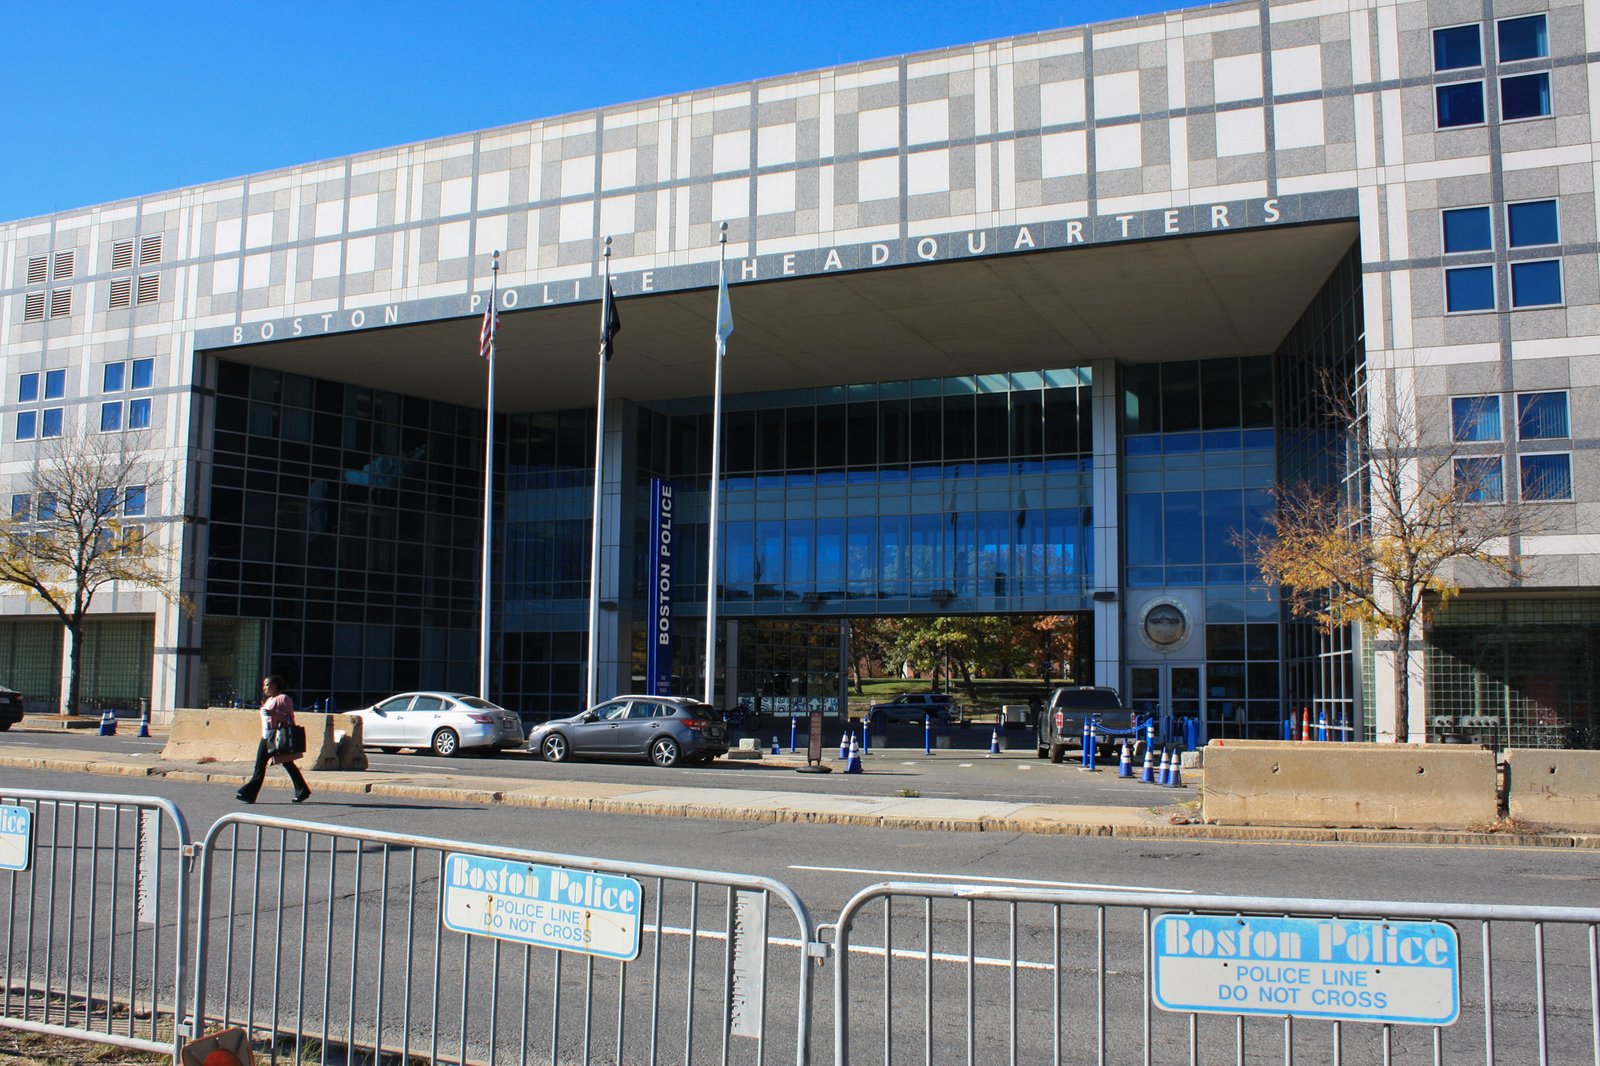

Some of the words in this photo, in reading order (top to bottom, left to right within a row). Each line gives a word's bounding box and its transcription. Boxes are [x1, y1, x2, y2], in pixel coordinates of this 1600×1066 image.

[233, 304, 399, 344] BOSTON
[741, 199, 1280, 279] HEADQUARTERS
[661, 485, 672, 557] POLICE
[659, 563, 671, 645] BOSTON
[453, 857, 540, 898] Boston
[550, 870, 635, 912] Police
[484, 912, 503, 928] DO
[509, 917, 536, 934] NOT
[543, 923, 592, 943] CROSS
[496, 899, 544, 919] POLICE
[551, 907, 580, 925] LINE
[1165, 919, 1301, 959] Boston
[1318, 923, 1449, 965] Police
[1218, 985, 1248, 1001] DO
[1259, 987, 1301, 1004] NOT
[1311, 989, 1388, 1009] CROSS
[1237, 965, 1310, 985] POLICE
[1322, 969, 1368, 987] LINE
